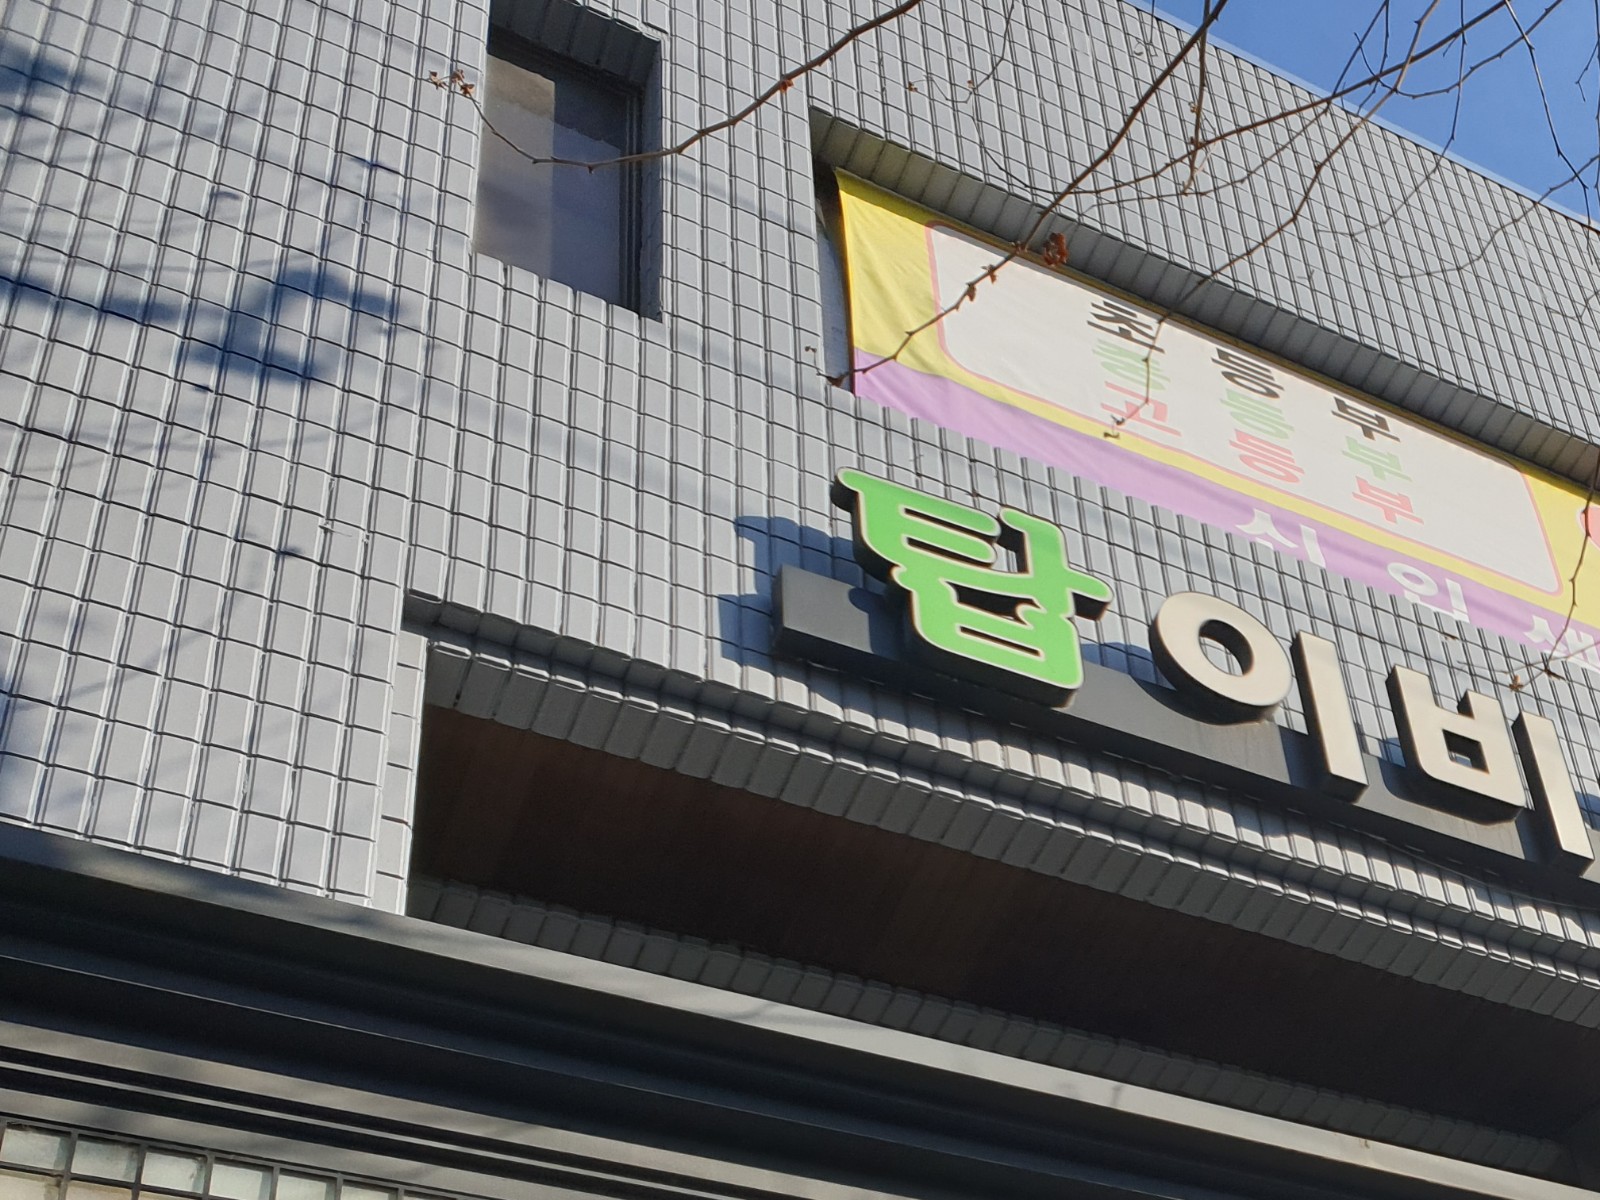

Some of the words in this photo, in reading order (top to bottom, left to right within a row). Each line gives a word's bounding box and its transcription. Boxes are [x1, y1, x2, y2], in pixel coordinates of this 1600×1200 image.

[1086, 299, 1401, 443] 초등부
[1091, 338, 1414, 484] 중등부
[1099, 380, 1425, 526] 고등부
